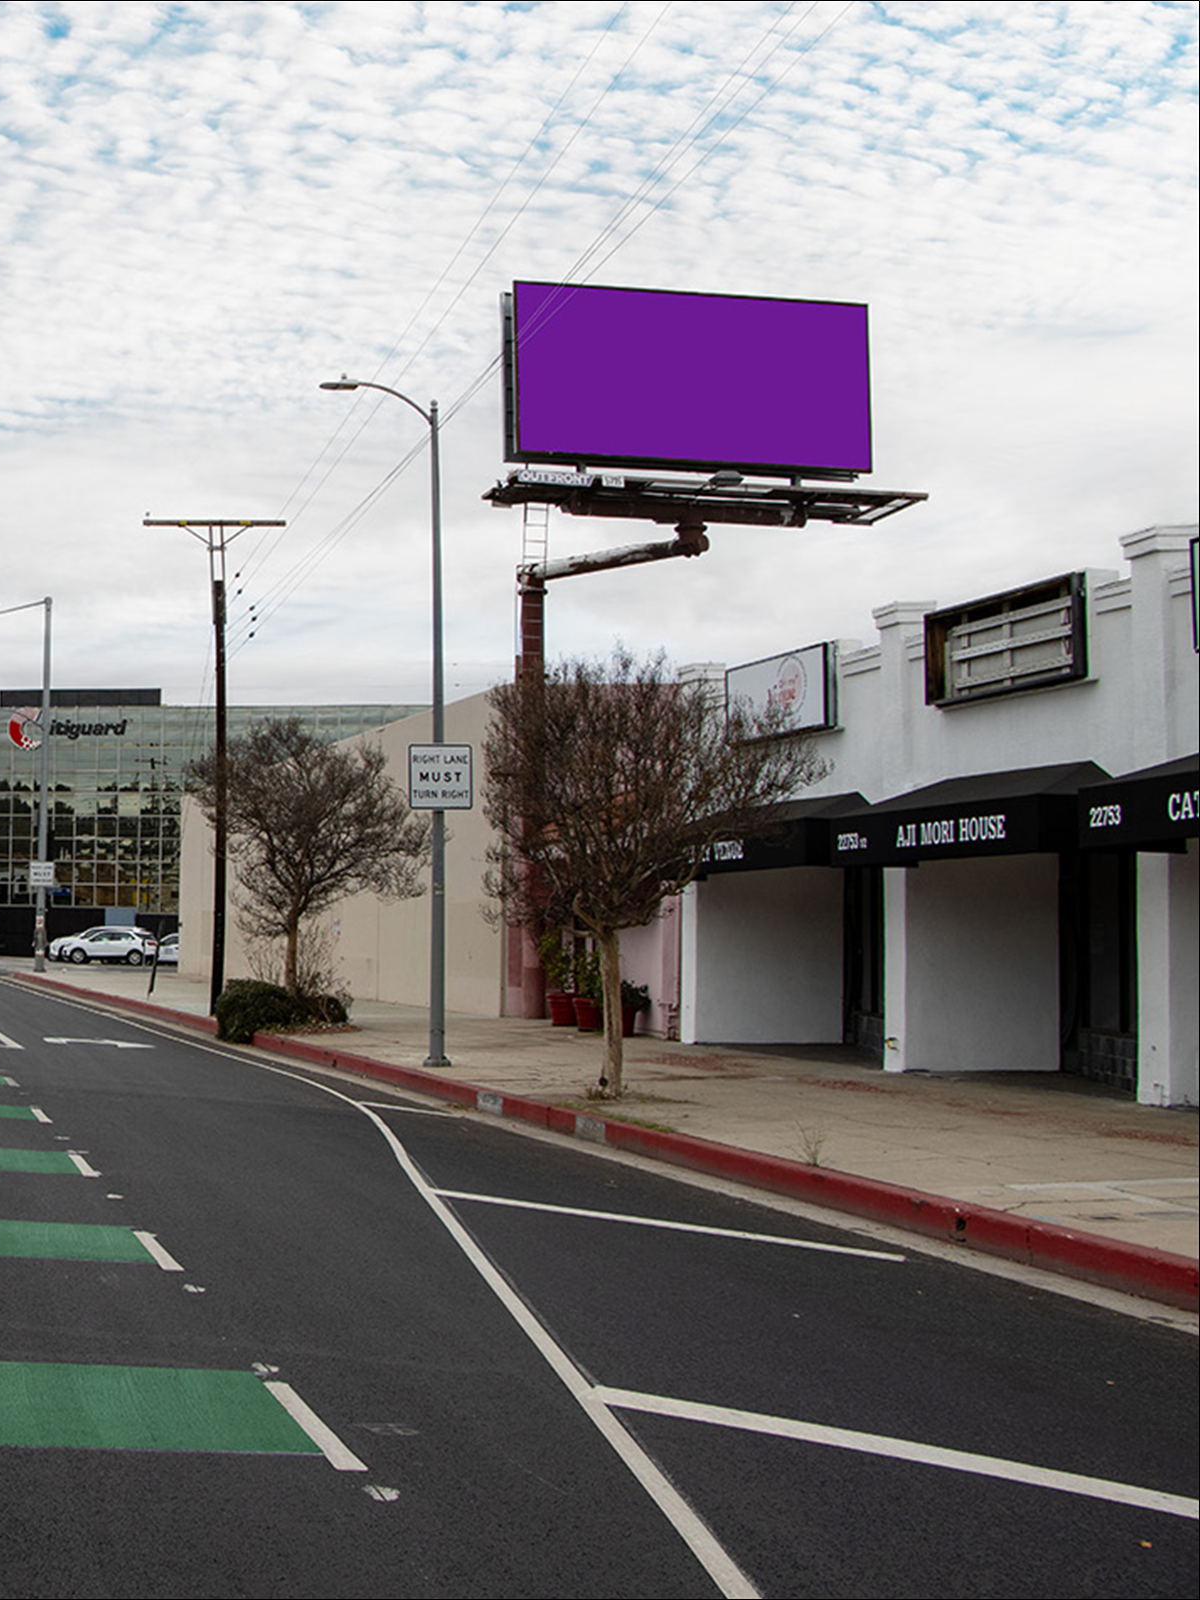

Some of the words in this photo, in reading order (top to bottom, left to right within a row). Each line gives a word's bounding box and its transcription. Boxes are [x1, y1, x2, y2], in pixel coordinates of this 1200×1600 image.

[520, 470, 591, 486] OUTFRONT
[413, 754, 440, 765] RIGHT
[443, 754, 469, 765] LANE
[419, 771, 462, 783] MUST
[413, 789, 438, 799] TURN
[441, 789, 469, 799] RIGHT
[1089, 804, 1122, 828] 22753
[896, 824, 916, 848] AJI
[920, 820, 954, 845] MORI
[959, 814, 1006, 841] HOUSE
[837, 832, 859, 850] 22753
